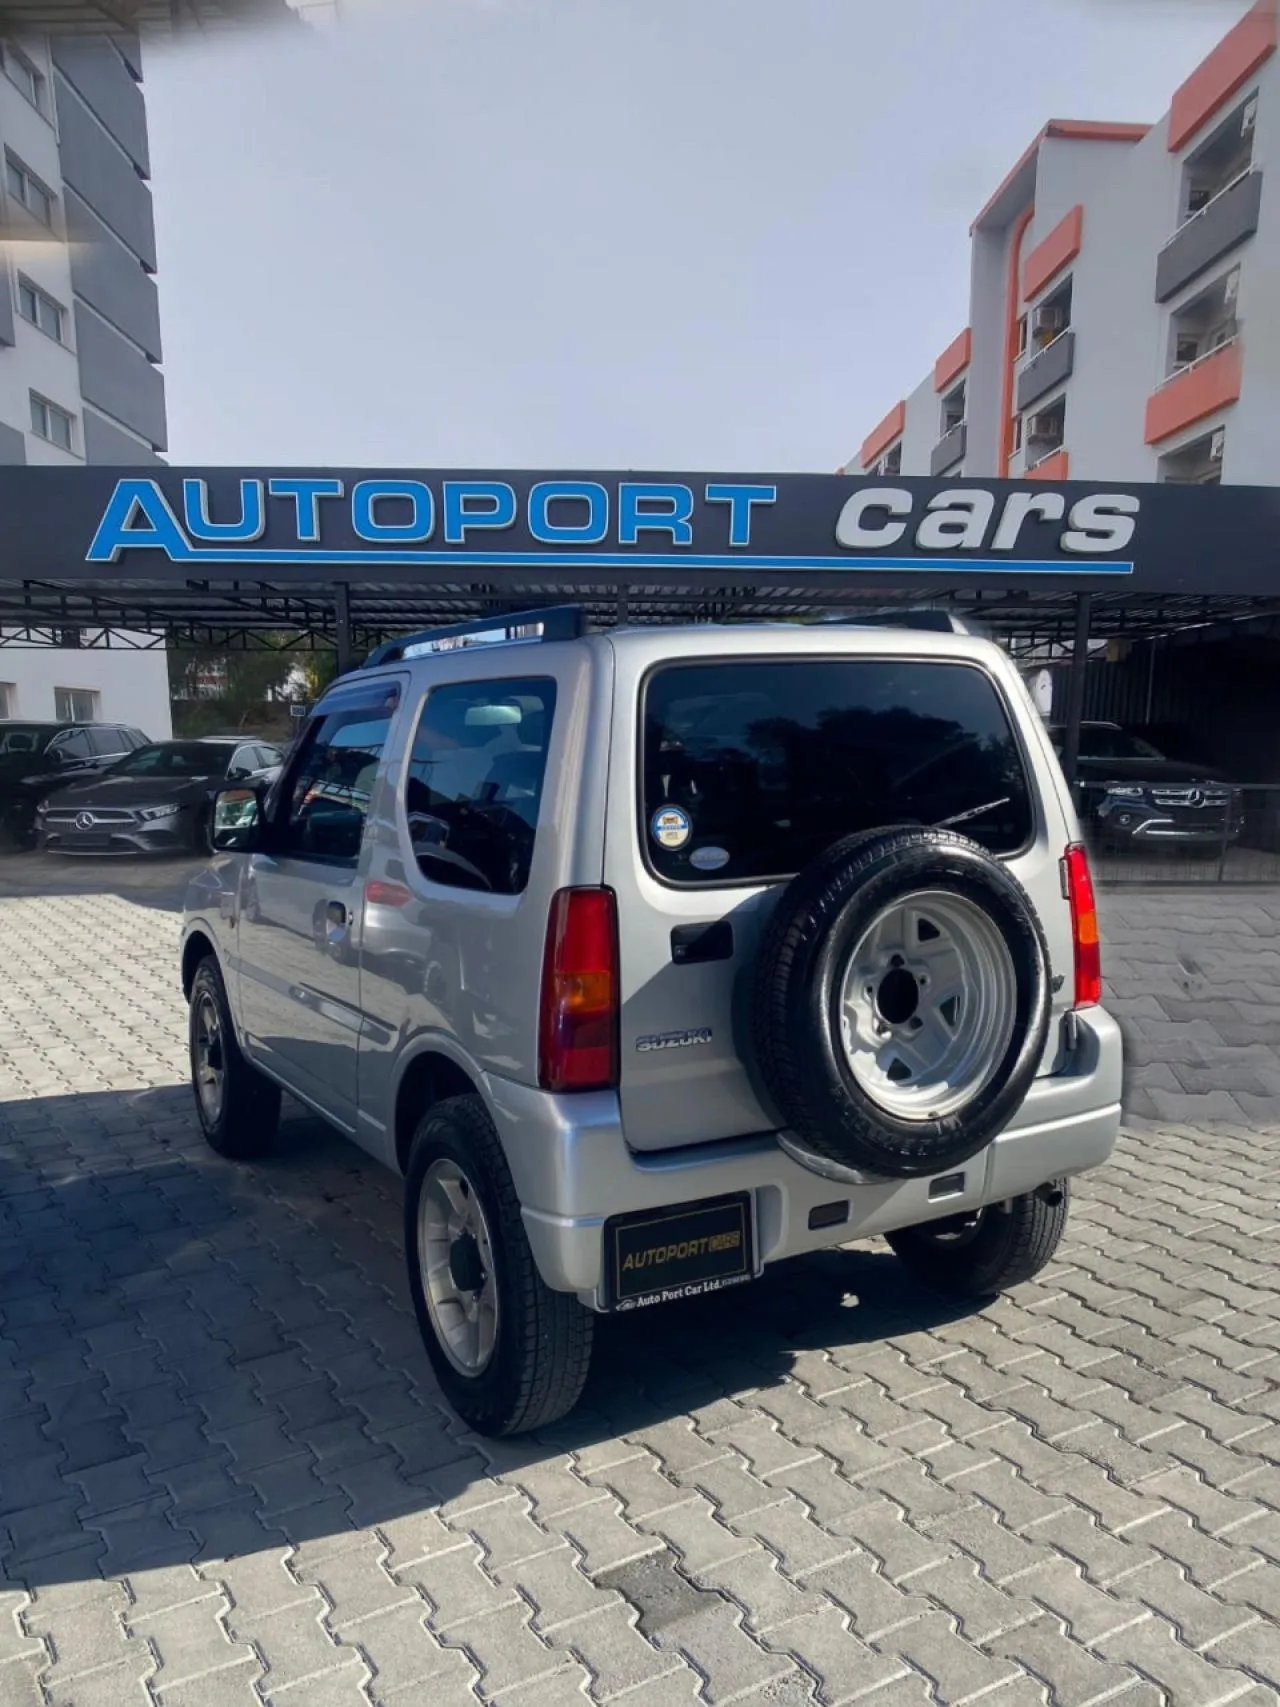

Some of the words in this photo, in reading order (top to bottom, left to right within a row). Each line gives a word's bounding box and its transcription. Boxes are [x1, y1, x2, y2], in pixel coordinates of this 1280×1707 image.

[85, 477, 778, 563] AUTOPORT
[835, 487, 1141, 554] cars
[635, 1027, 713, 1052] SUZUKI
[622, 1238, 709, 1271] AUTOPORT
[636, 1294, 661, 1308] Auto
[661, 1288, 684, 1302] Port
[684, 1284, 702, 1297] Car
[703, 1279, 723, 1292] Ltd.
